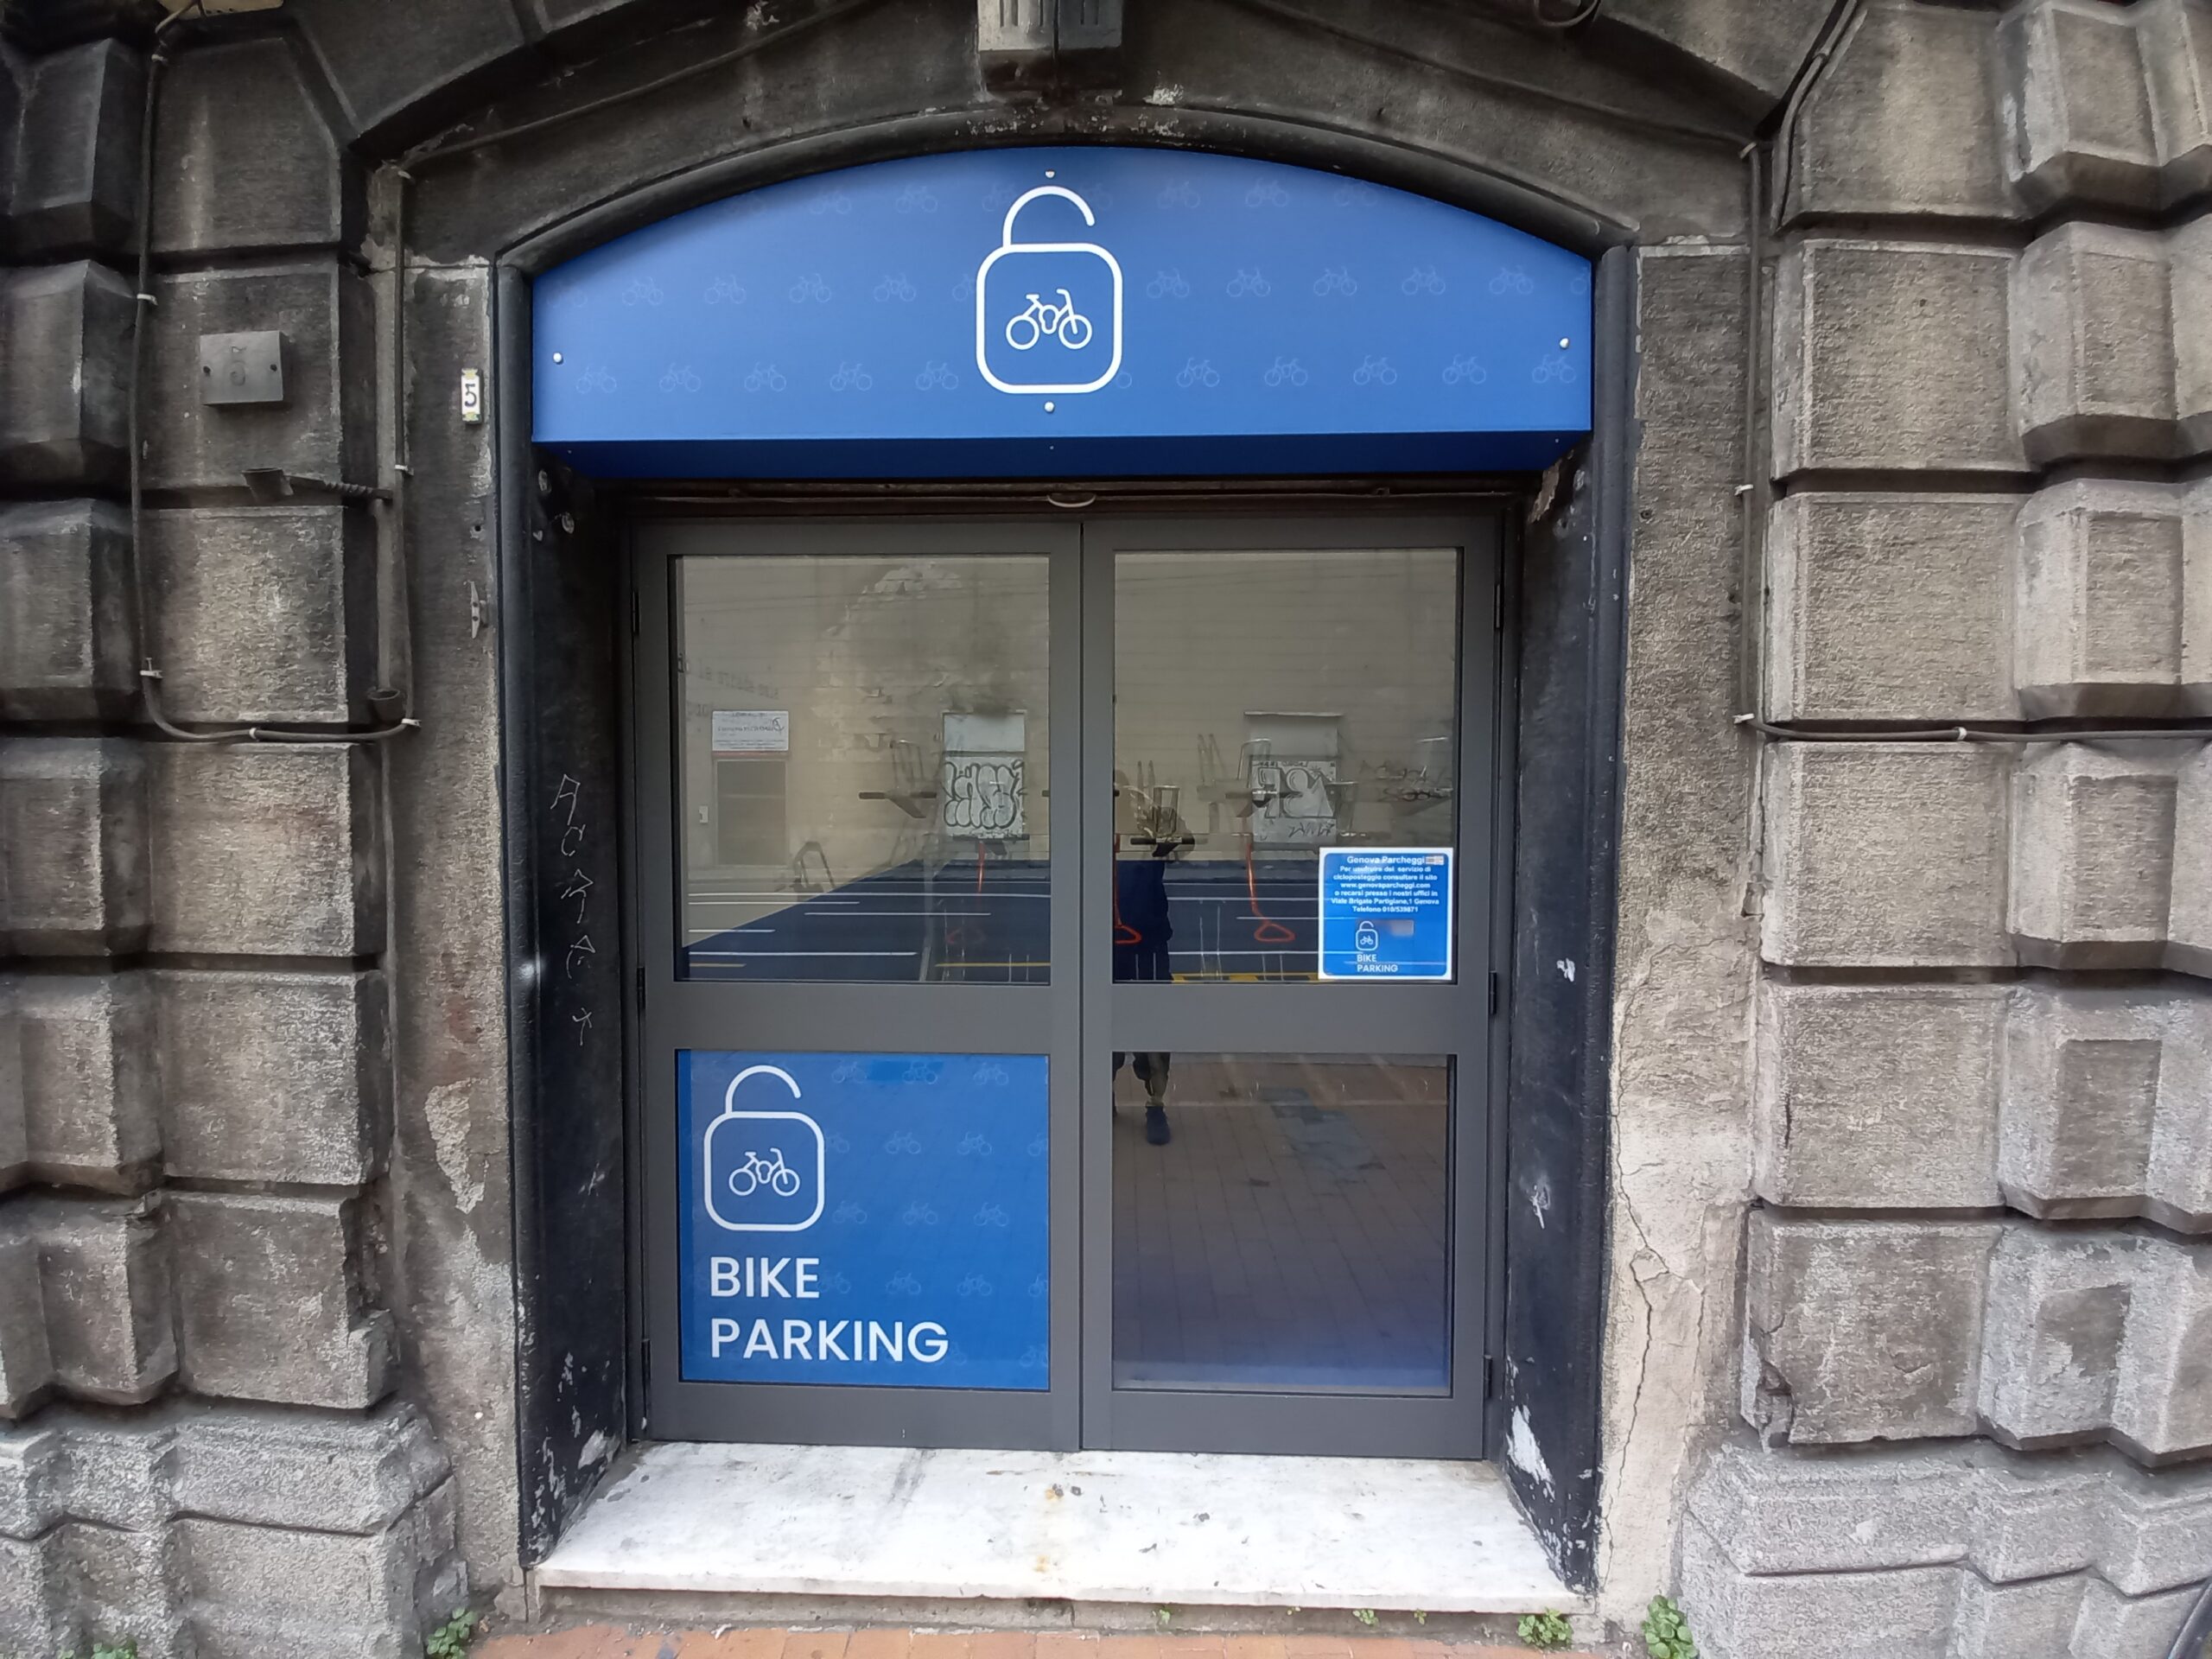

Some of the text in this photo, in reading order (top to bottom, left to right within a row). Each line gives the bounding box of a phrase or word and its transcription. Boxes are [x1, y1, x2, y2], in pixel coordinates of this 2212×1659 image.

[464, 383, 477, 407] 5
[1382, 856, 1425, 865] Parcheggi
[710, 1256, 820, 1299] BIKE
[711, 1318, 949, 1363] PARKING
